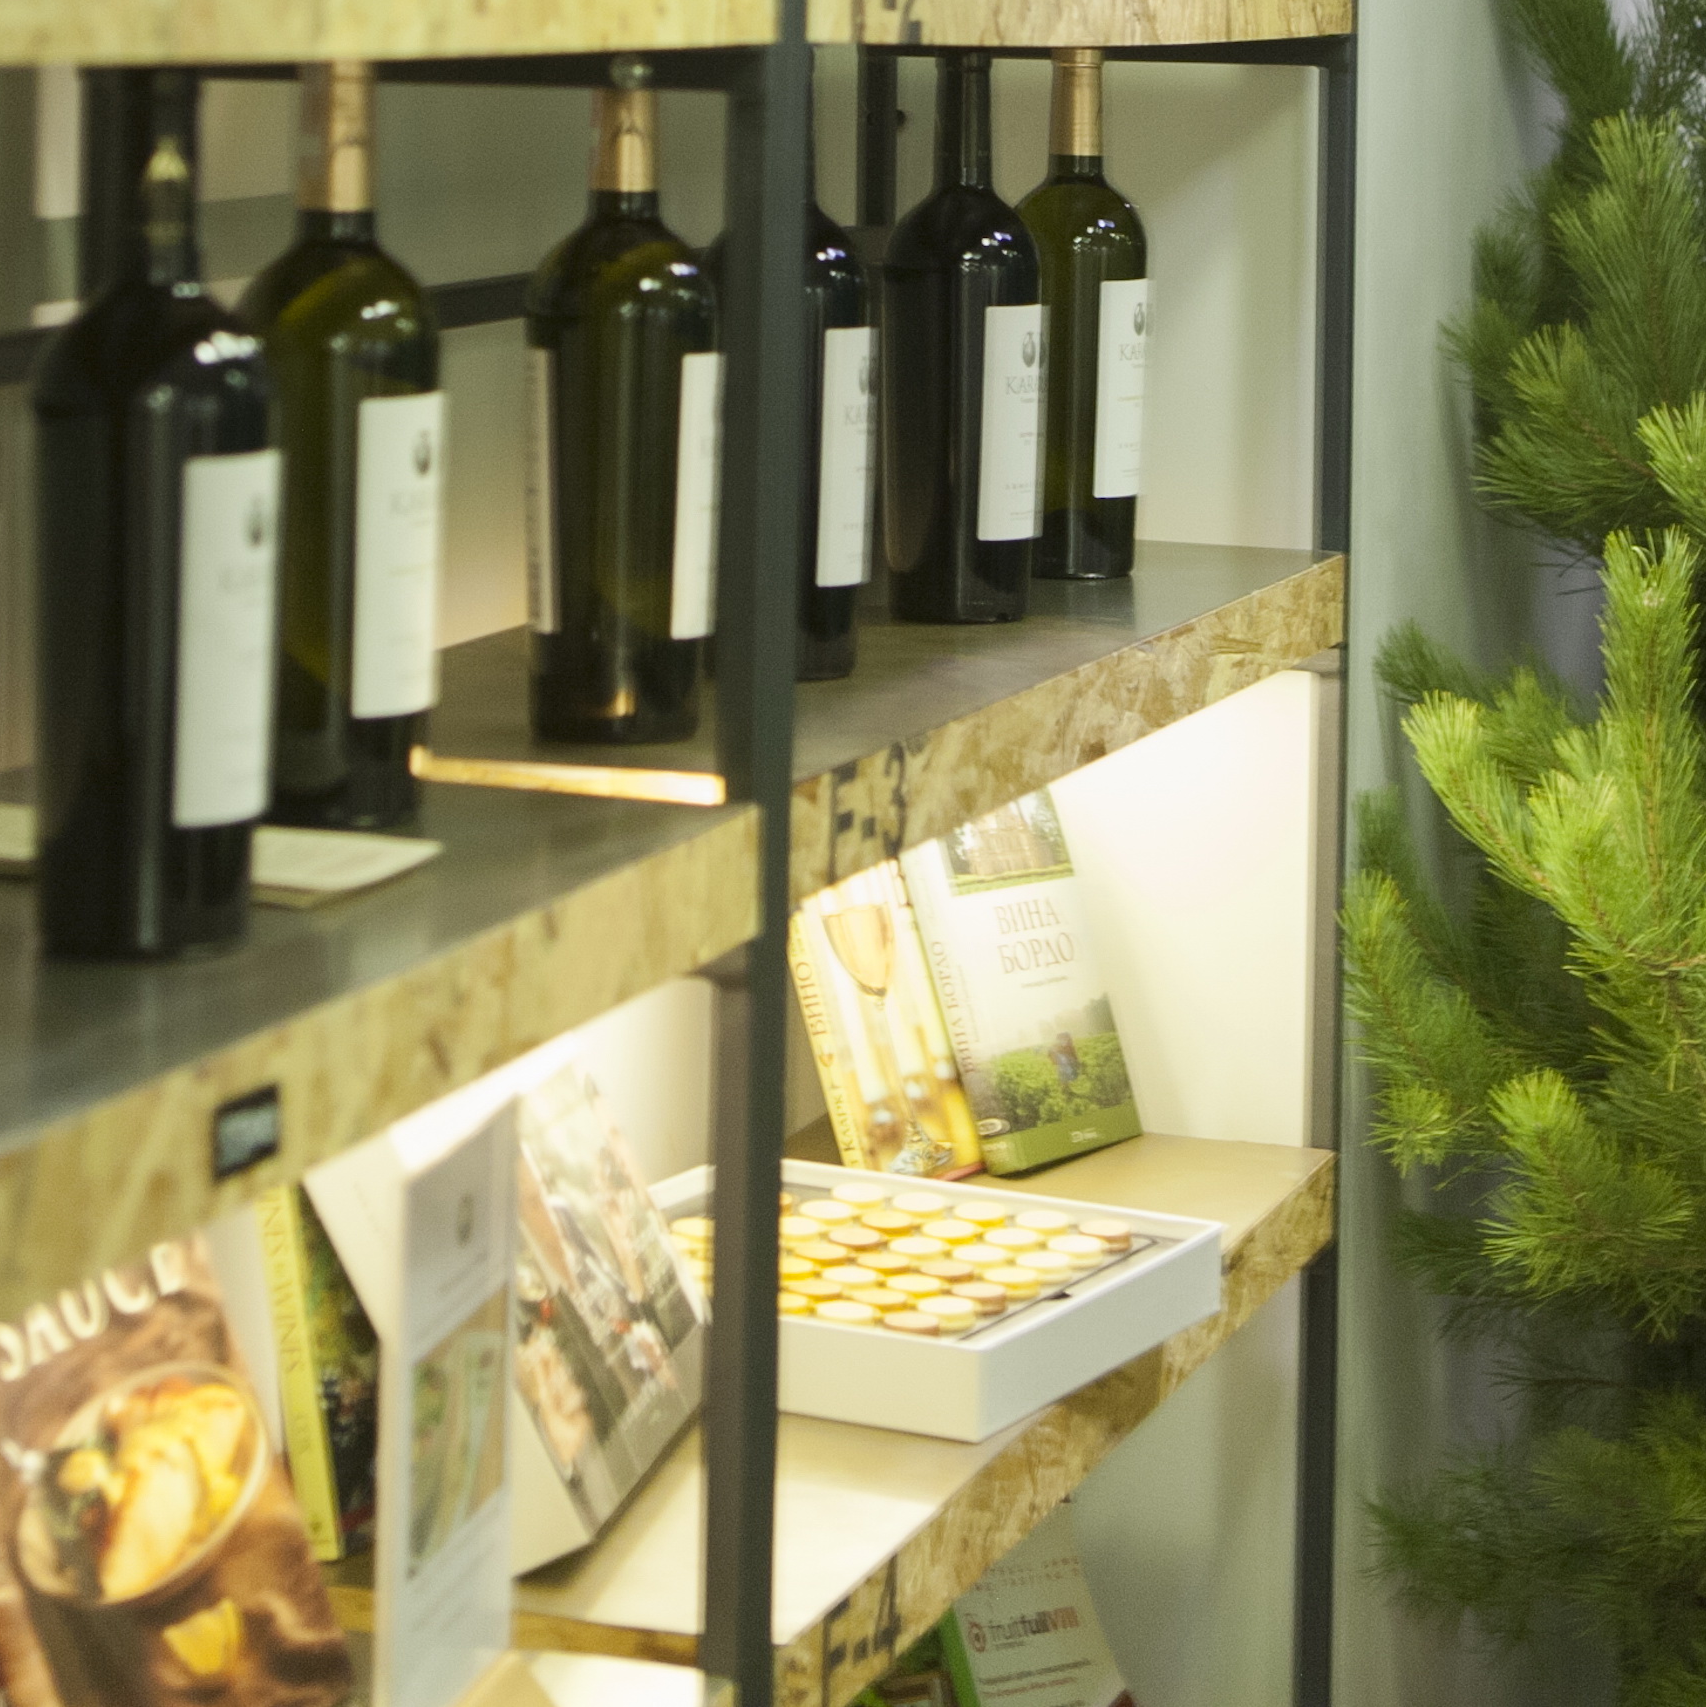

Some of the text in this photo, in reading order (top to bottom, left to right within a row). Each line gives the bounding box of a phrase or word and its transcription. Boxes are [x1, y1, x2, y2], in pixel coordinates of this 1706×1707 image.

[993, 896, 1062, 935] ВИНА
[996, 931, 1075, 975] БОРДО
[795, 961, 828, 1037] ВИНО
